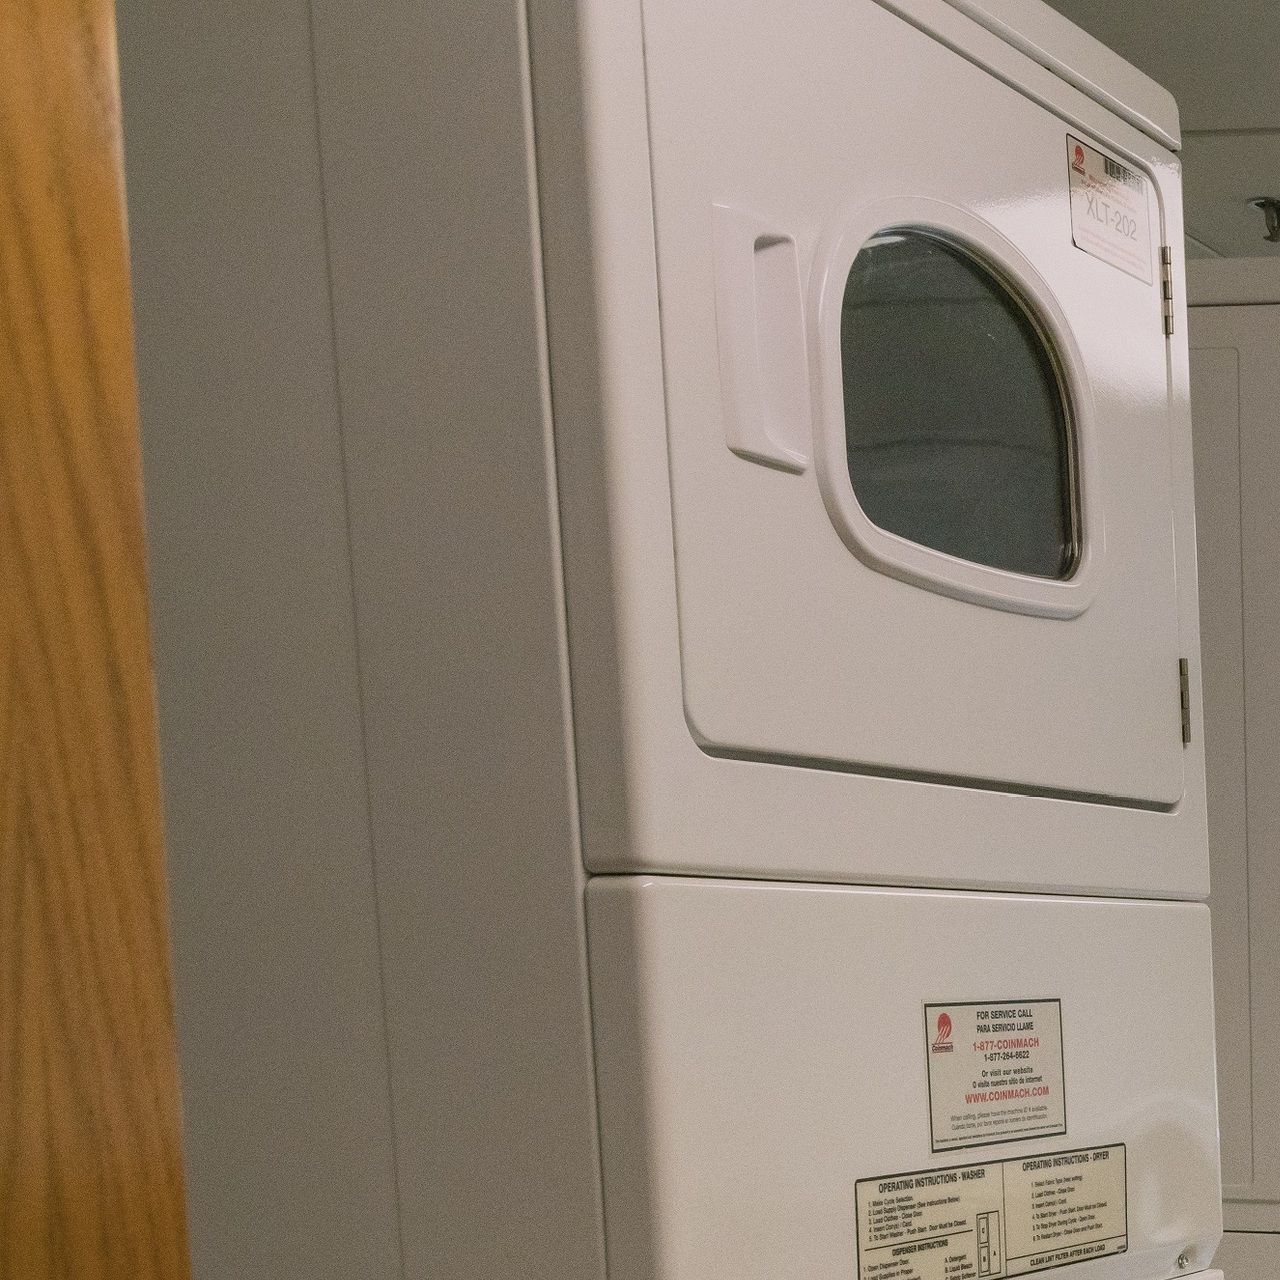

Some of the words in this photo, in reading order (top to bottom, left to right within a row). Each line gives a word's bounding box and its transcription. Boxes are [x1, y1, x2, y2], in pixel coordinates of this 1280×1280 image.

[1086, 193, 1137, 241] XLT-202
[977, 1011, 989, 1020] FOR
[990, 1010, 1016, 1019] SERVICE
[1017, 1009, 1032, 1018] CALL
[977, 1024, 990, 1033] PARA
[992, 1022, 1016, 1032] SERVICIO
[1017, 1022, 1033, 1031] LLAME
[972, 1037, 1039, 1051] 1-877-COINMACH
[990, 1069, 1001, 1077] visit
[1013, 1067, 1033, 1075] website
[965, 1086, 1049, 1104] WWW.COINMACH.COM
[1022, 1159, 1052, 1172] OPERATING
[1053, 1154, 1089, 1168] INSTRUCTIONS
[1093, 1151, 1110, 1161] DRYER
[879, 1180, 915, 1193] OPERATING
[915, 1173, 958, 1188] INSTRUCTIONS
[961, 1169, 986, 1181] WASHER
[892, 1245, 917, 1257] DISPENSER
[917, 1239, 949, 1252] INSTRUCTIONS
[1029, 1256, 1045, 1267] CLEAN
[1045, 1254, 1055, 1264] LINT
[1055, 1251, 1069, 1261] FILTER
[1069, 1249, 1082, 1259] AFTER
[1083, 1246, 1095, 1256] EACH
[1095, 1244, 1106, 1253] LOAD
